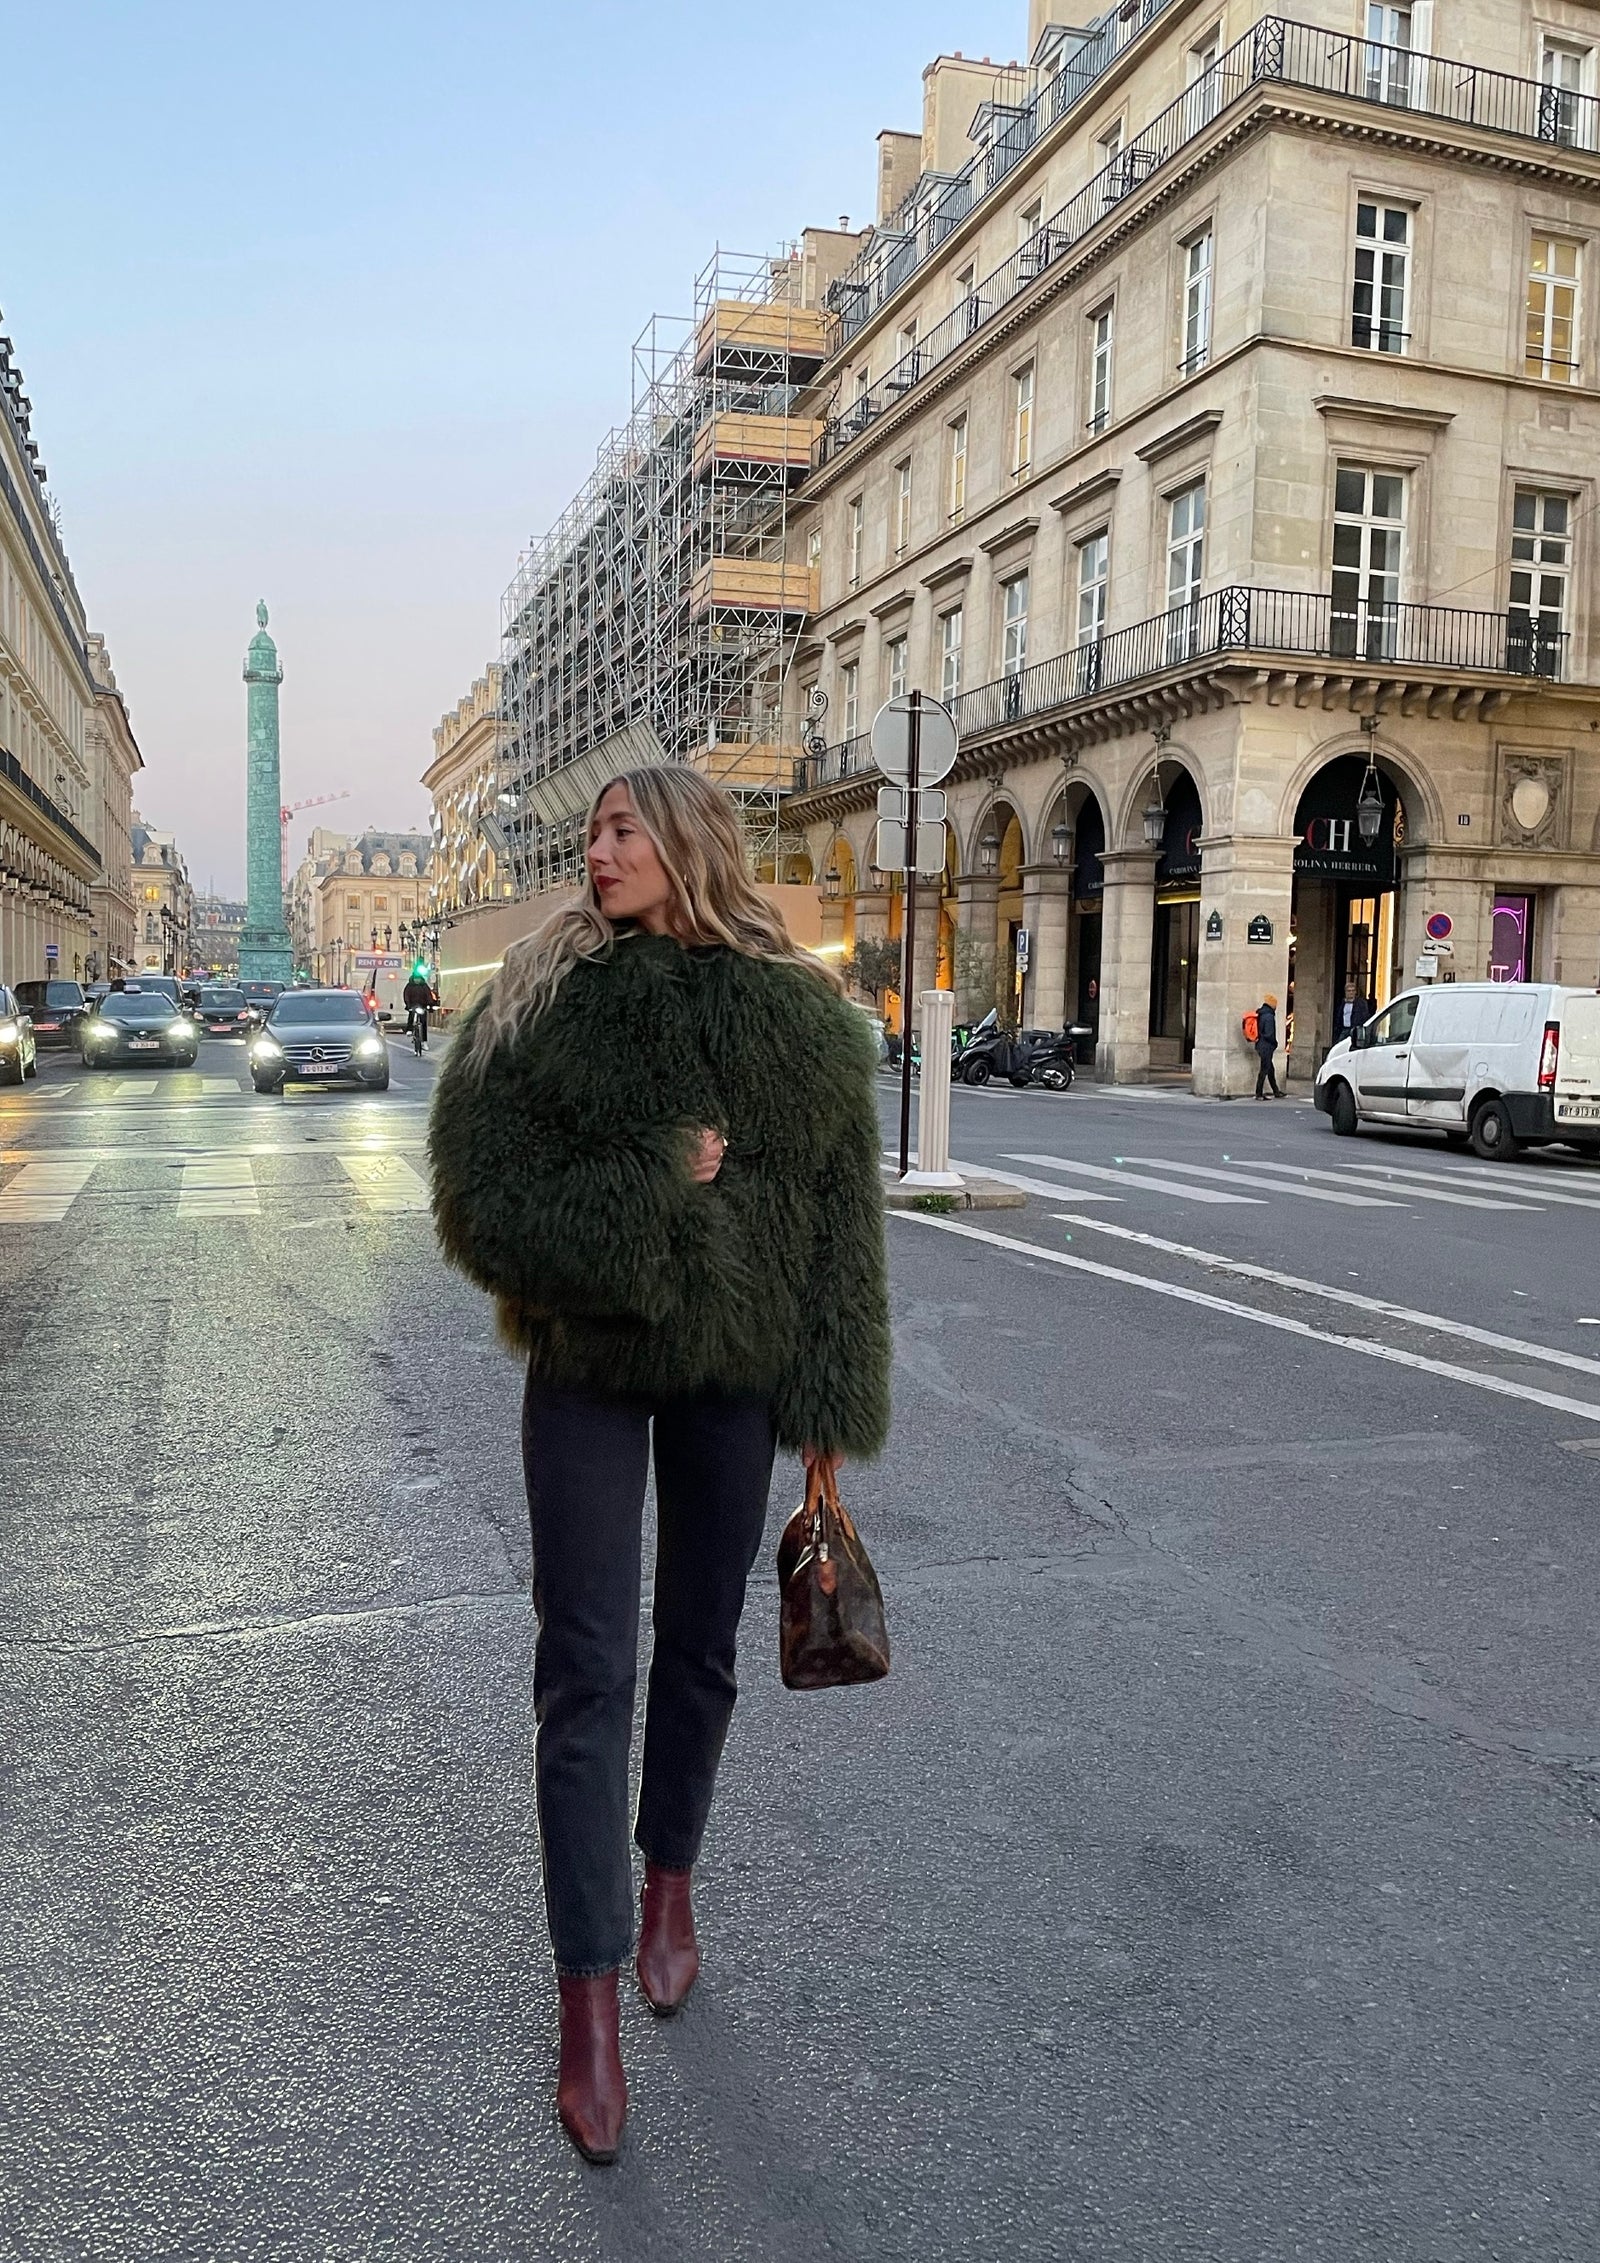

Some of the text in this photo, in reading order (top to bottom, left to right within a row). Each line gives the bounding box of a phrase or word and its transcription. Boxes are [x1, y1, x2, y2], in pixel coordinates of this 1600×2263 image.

[1306, 818, 1353, 852] CH
[1331, 861, 1378, 872] HERRERA
[358, 959, 376, 967] RENT
